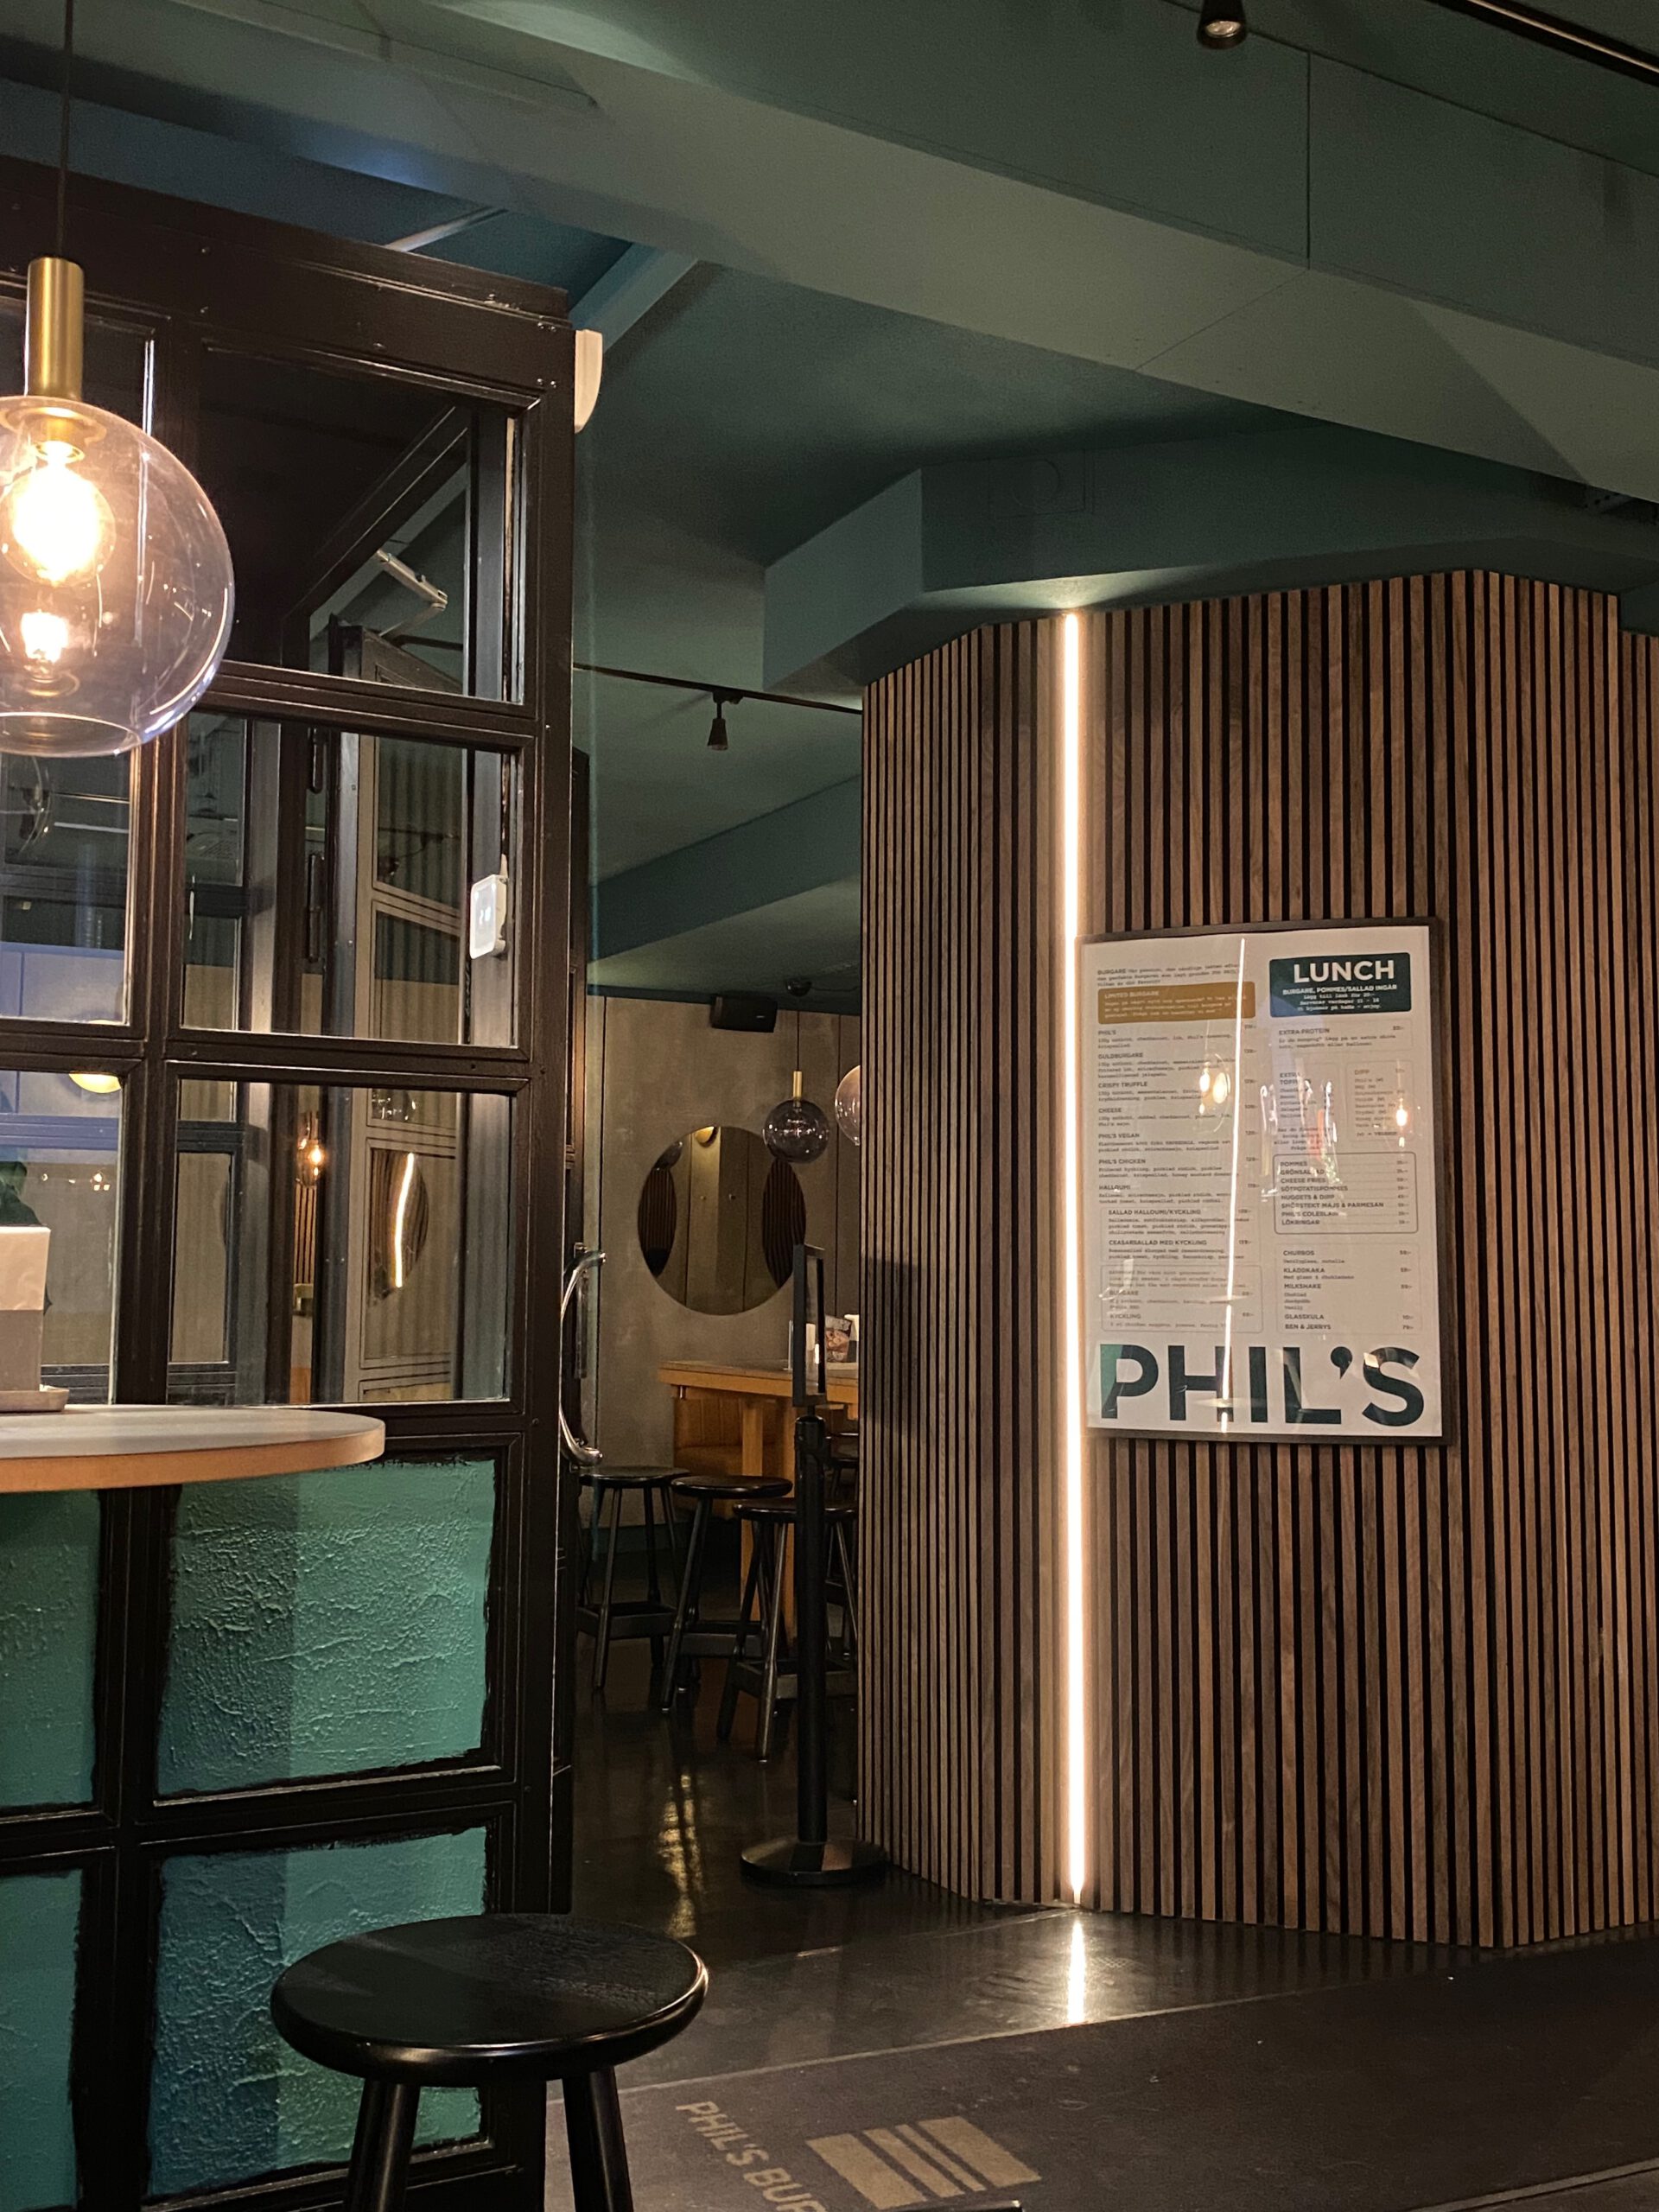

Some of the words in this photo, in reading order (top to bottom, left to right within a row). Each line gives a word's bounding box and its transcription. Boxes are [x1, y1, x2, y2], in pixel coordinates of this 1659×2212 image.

[1294, 959, 1395, 983] LUNCH
[1100, 1343, 1424, 1427] PHIL'S
[676, 2101, 769, 2167] PHIL'S
